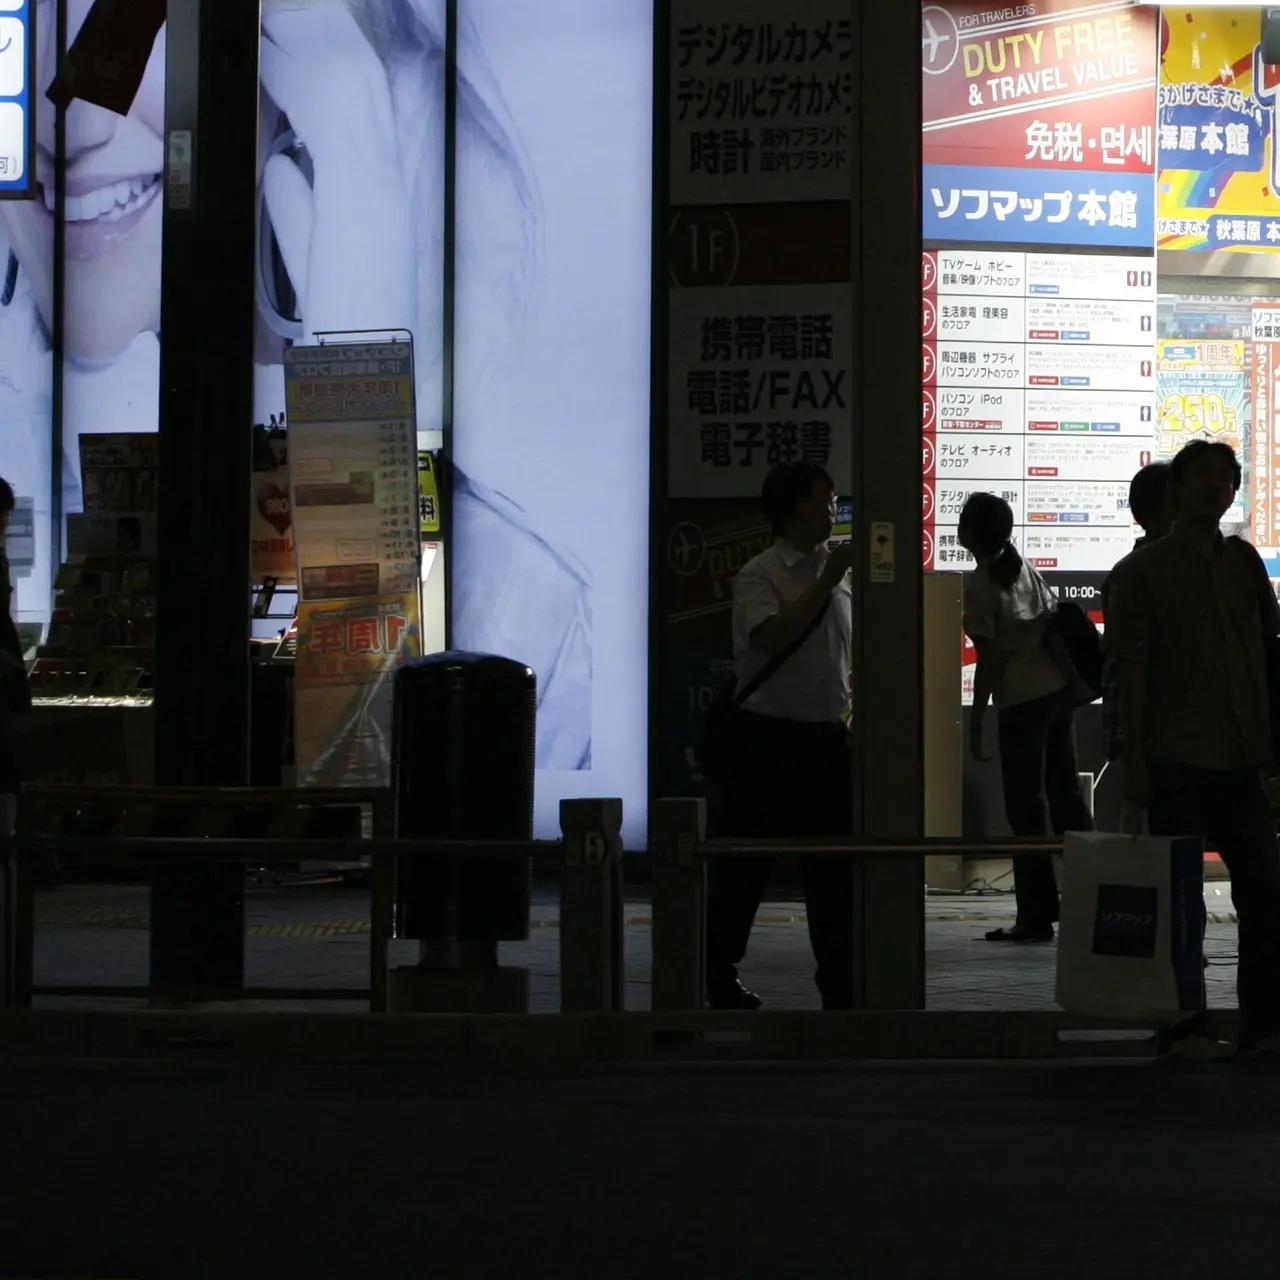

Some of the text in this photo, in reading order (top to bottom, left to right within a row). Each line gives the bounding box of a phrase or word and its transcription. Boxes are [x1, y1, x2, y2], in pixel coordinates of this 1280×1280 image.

[959, 4, 1035, 28] FOR TRAVELERS
[963, 15, 1135, 78] DUTY FREE
[677, 74, 852, 121] デジタルビデオカメ
[968, 53, 1138, 106] & TRAVEL VALUE
[690, 128, 754, 174] 時計
[1159, 122, 1249, 155] 葉原 本館
[931, 188, 1137, 229] ソフマップ 本館
[687, 223, 725, 271] 1F
[701, 316, 834, 361] 携帯電話
[687, 371, 846, 415] 電話/FAX
